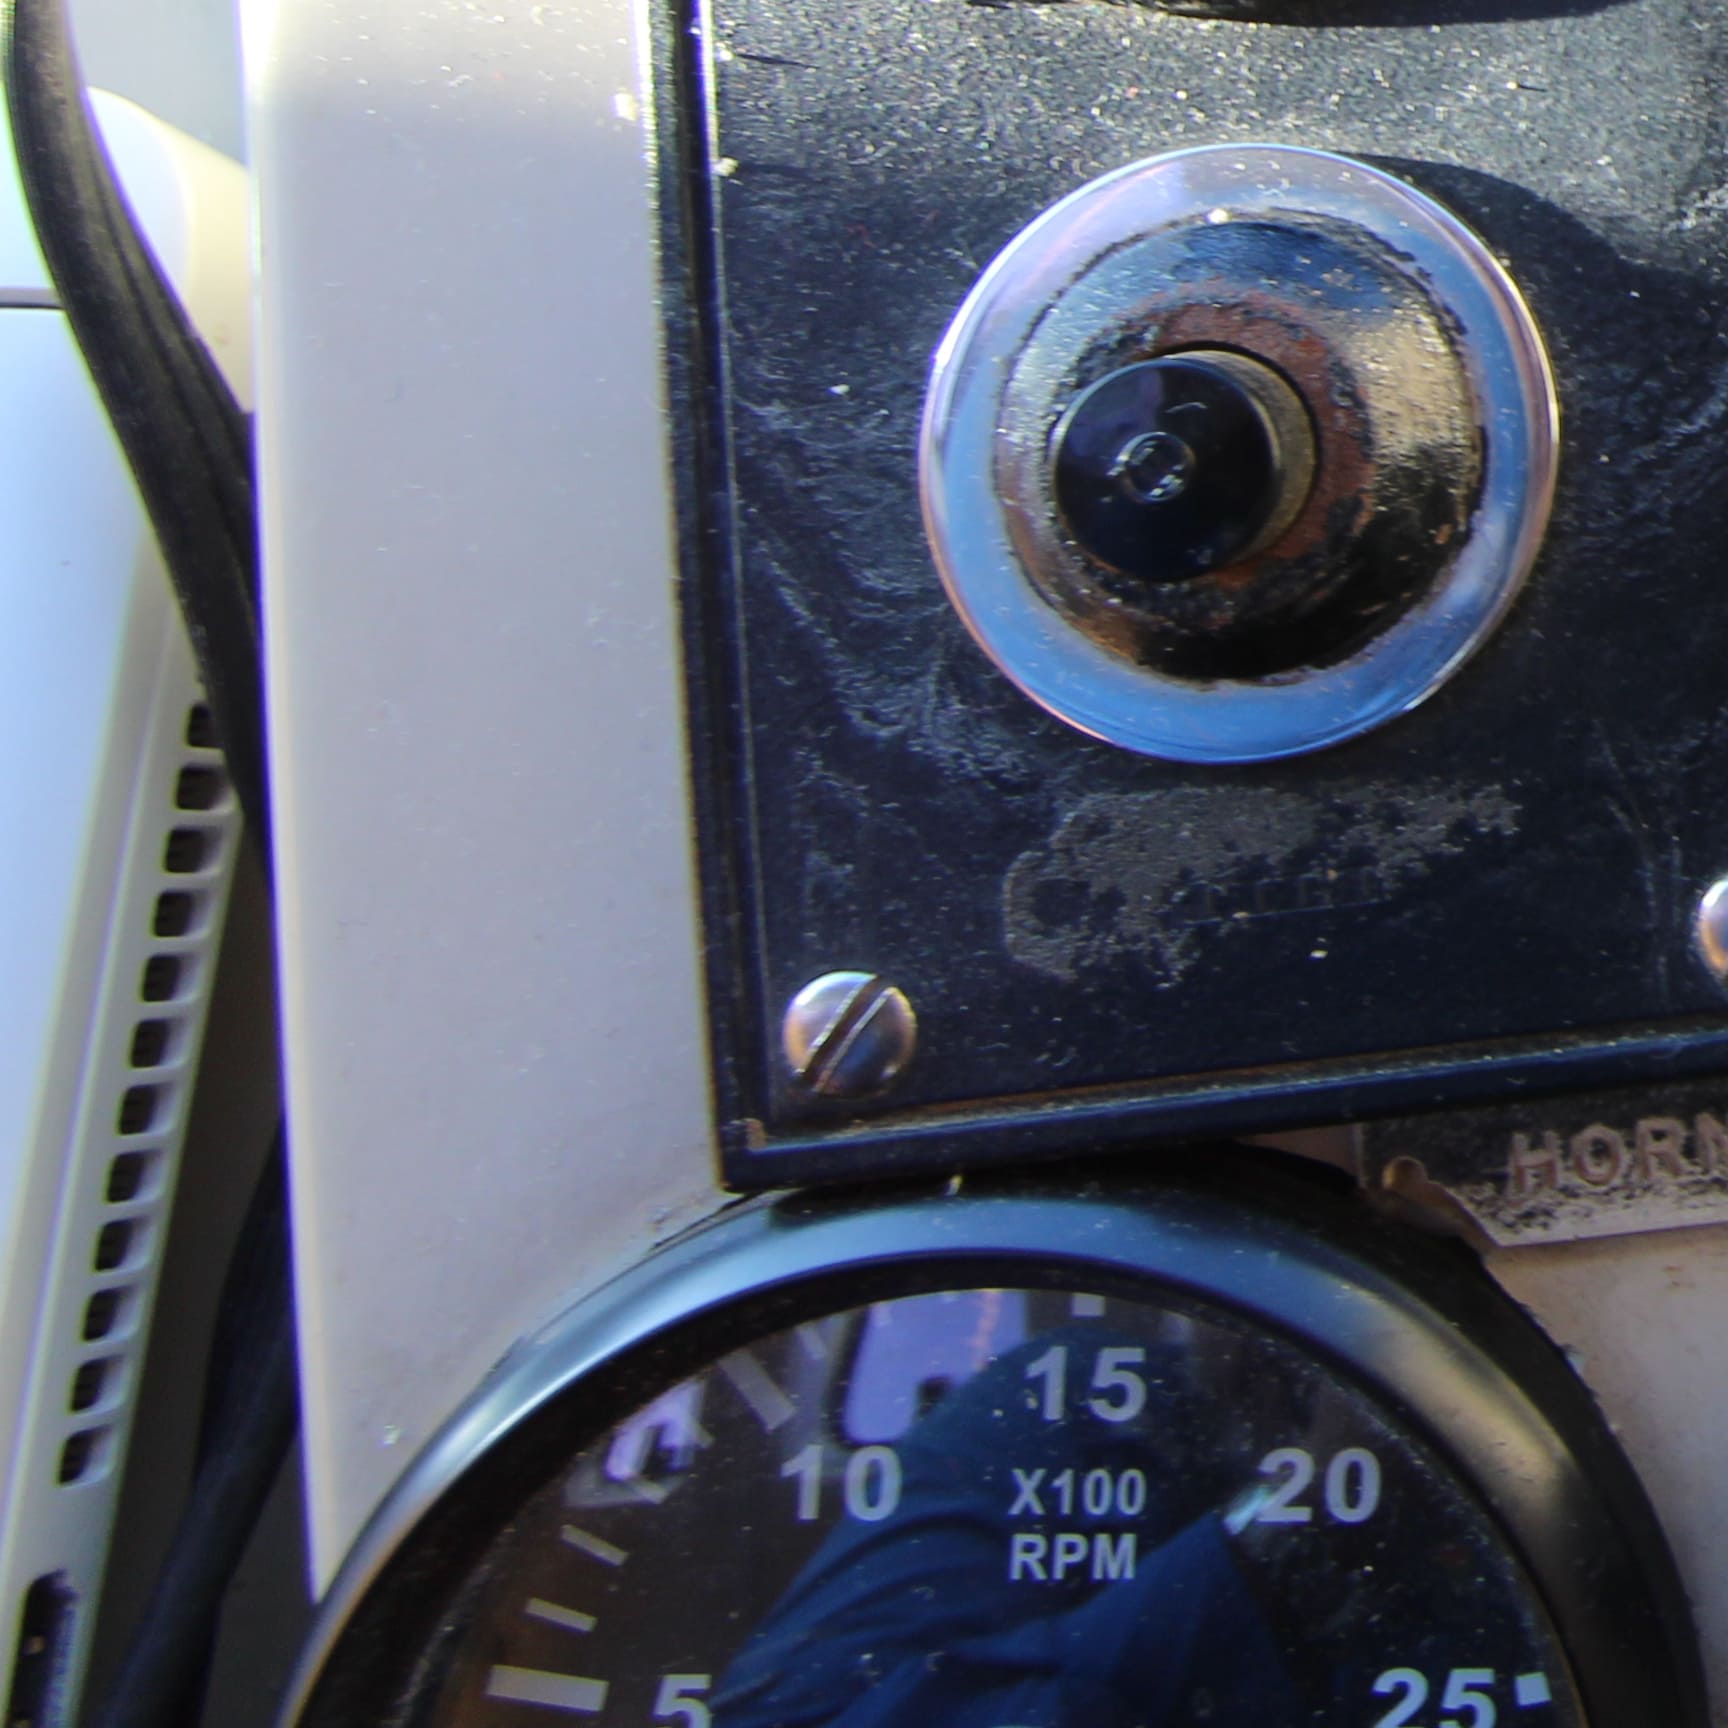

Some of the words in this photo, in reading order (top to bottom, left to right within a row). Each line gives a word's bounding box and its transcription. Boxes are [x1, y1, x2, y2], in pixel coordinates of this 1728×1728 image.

[1026, 1345, 1147, 1423] 15
[780, 1444, 901, 1522] 10
[1008, 1469, 1147, 1517] X100
[1256, 1447, 1382, 1524] 20
[1008, 1533, 1137, 1581] RPM
[652, 1673, 713, 1728] 5
[1371, 1667, 1497, 1728] 25
